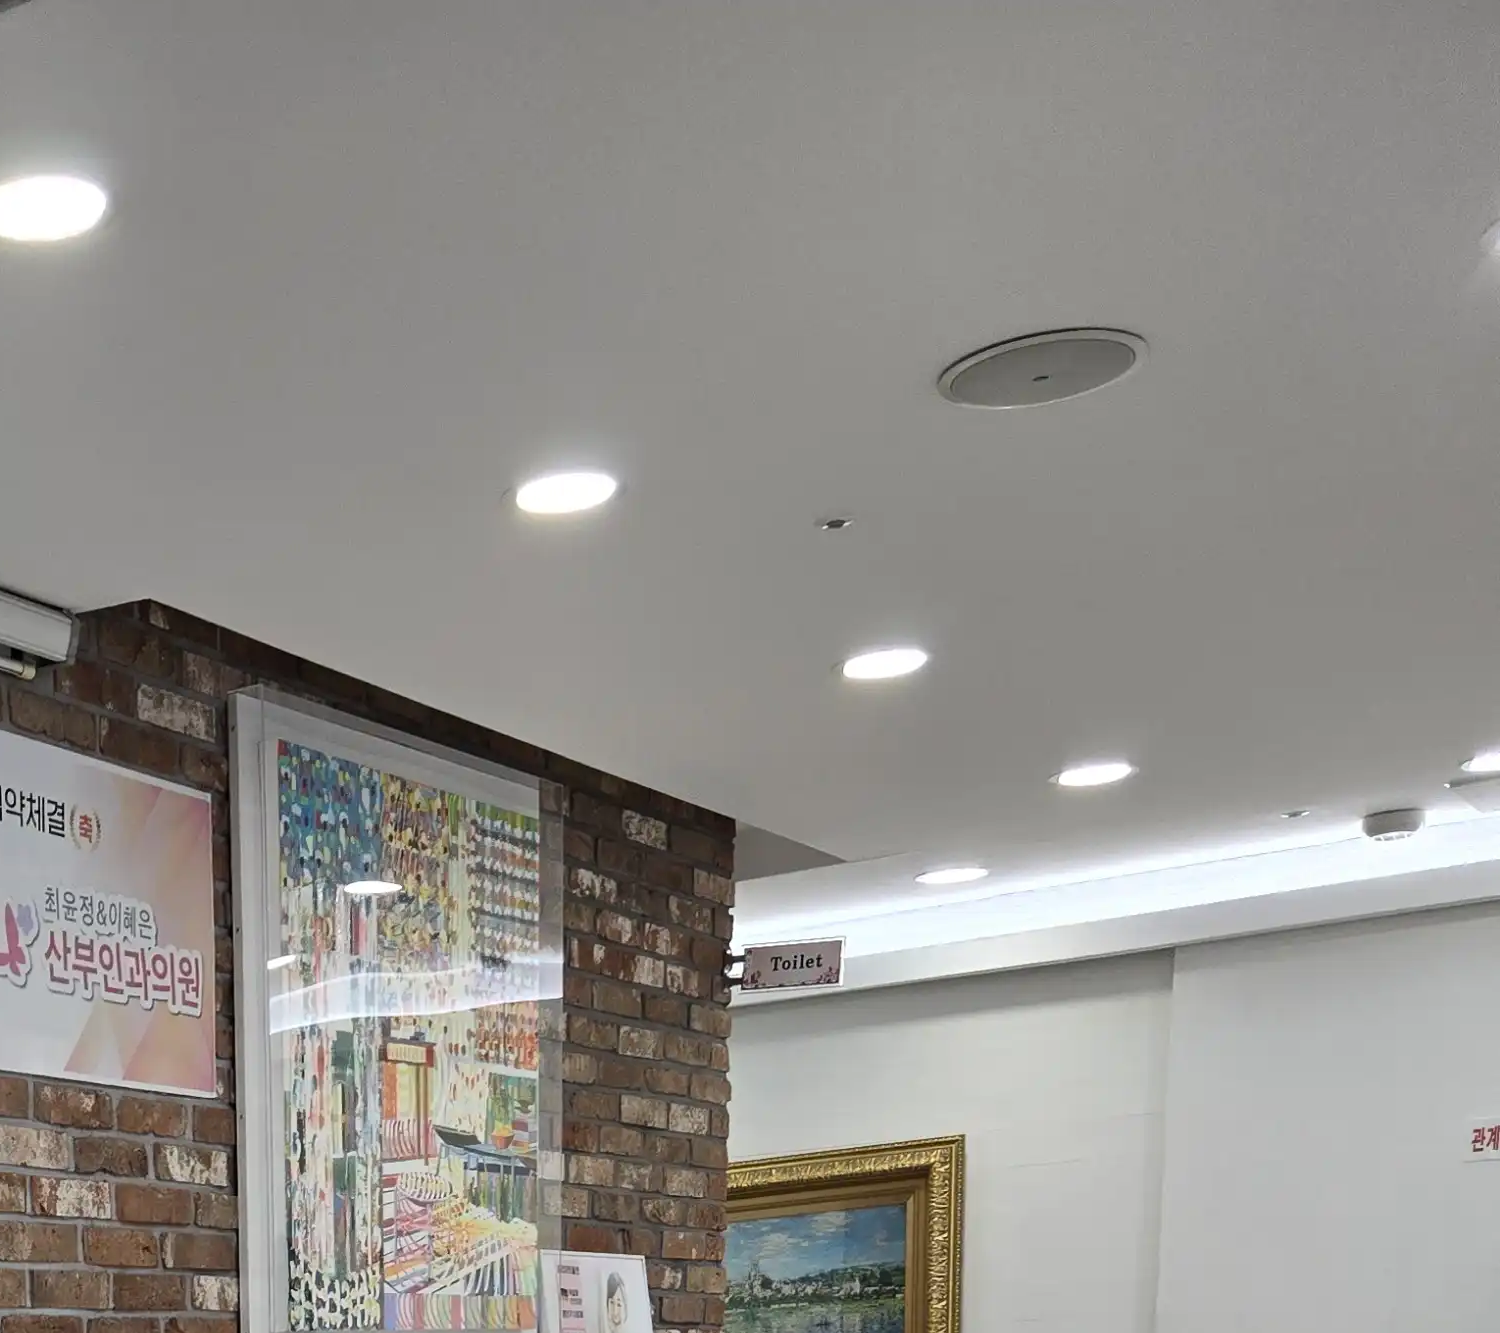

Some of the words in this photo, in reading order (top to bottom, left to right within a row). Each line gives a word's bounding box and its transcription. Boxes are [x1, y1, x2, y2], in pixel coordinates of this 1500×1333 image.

[77, 814, 94, 843] 축
[45, 886, 153, 940] 최윤정&이혜은
[45, 930, 199, 1008] 산부인과의원
[770, 953, 824, 972] Toilet
